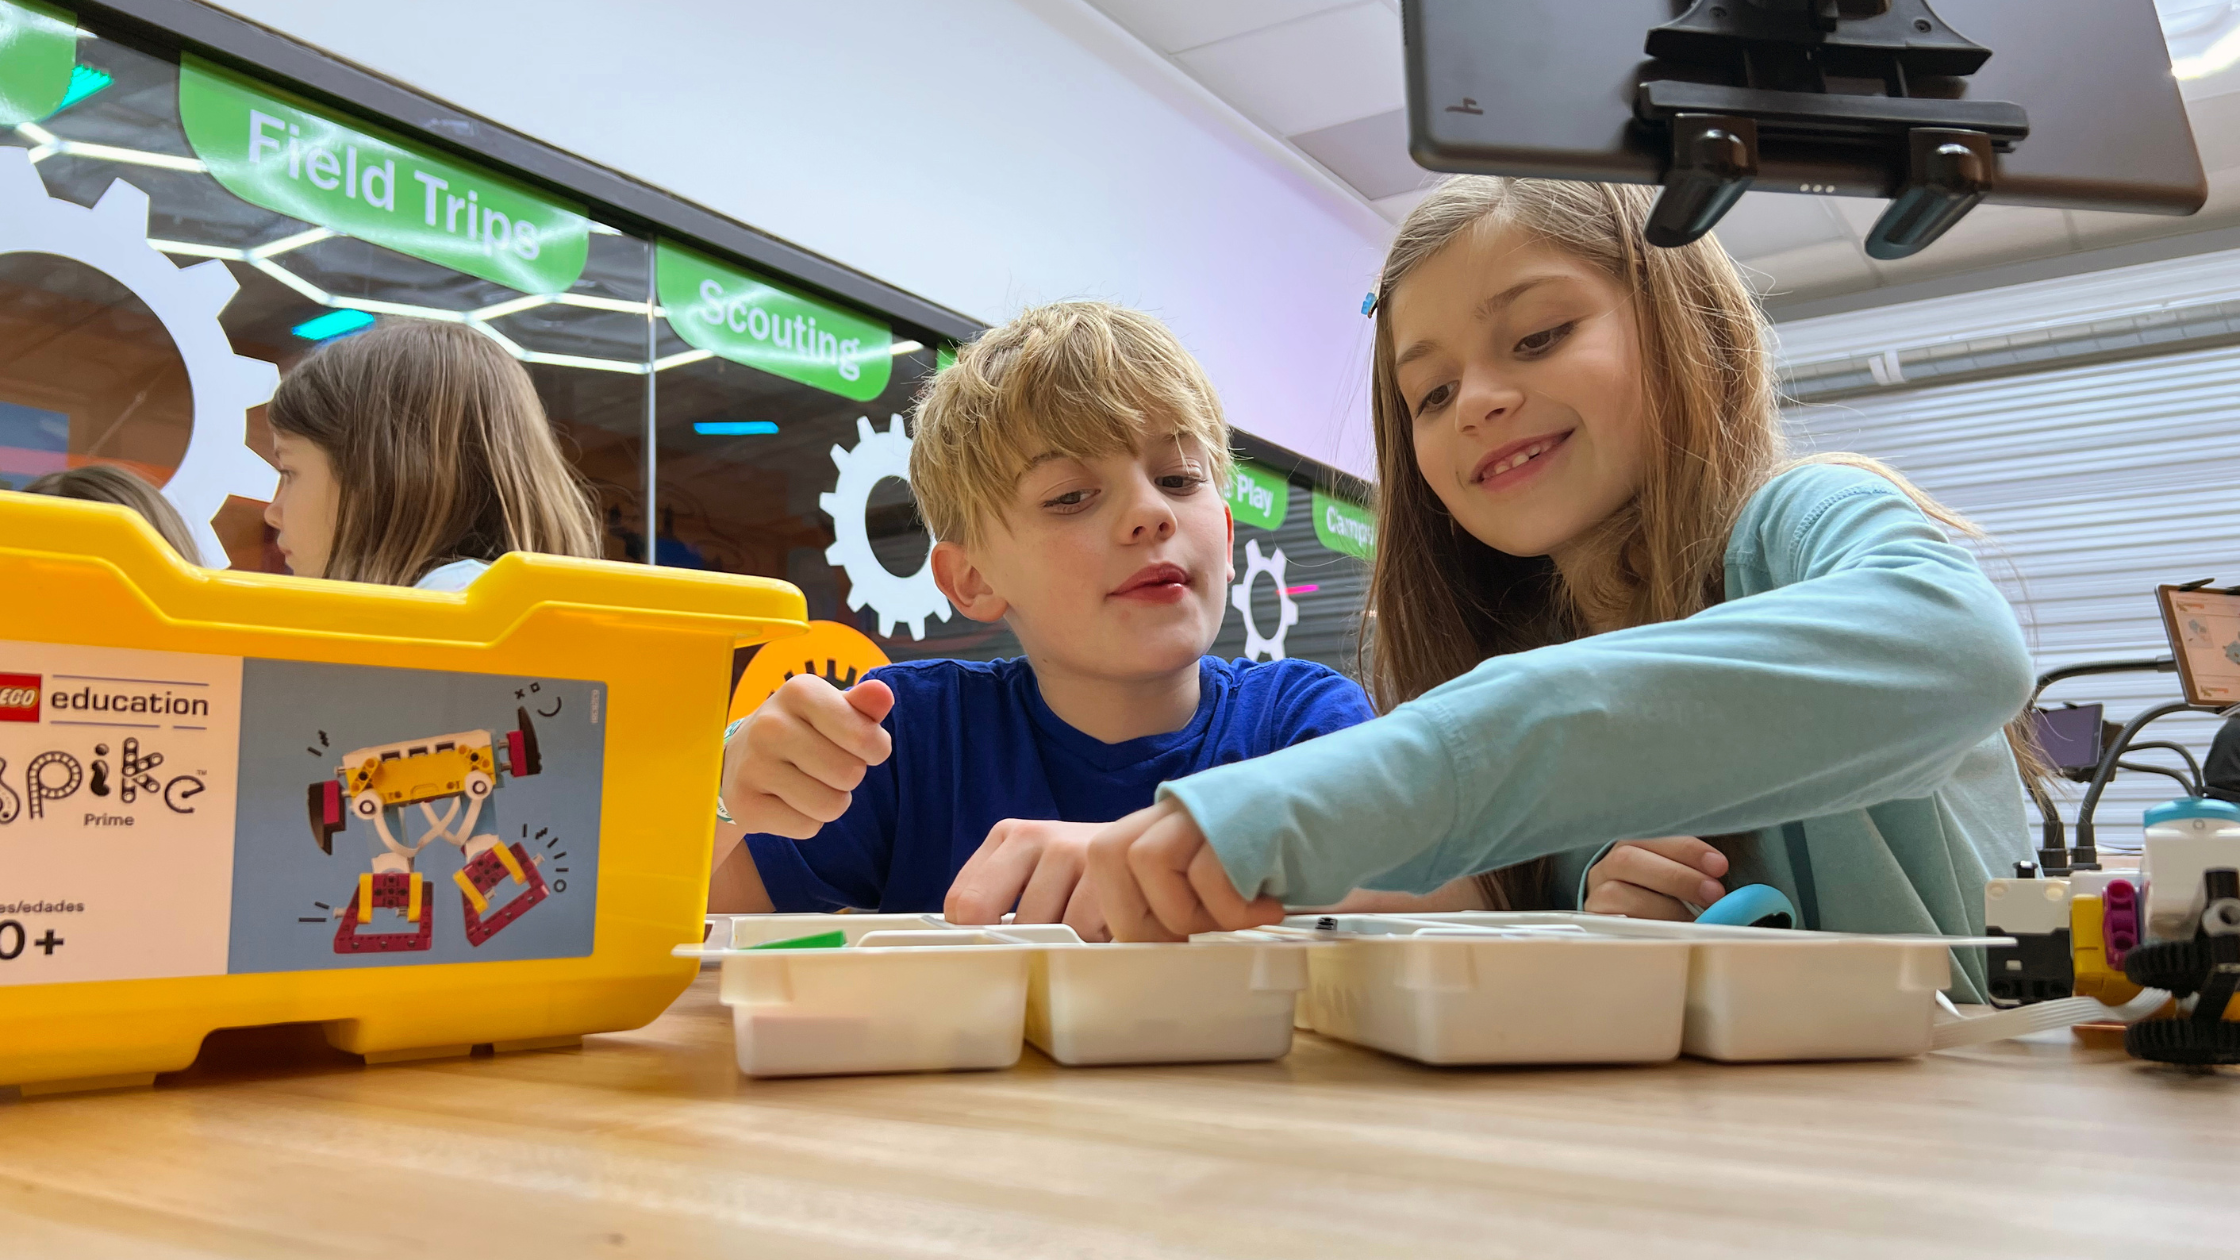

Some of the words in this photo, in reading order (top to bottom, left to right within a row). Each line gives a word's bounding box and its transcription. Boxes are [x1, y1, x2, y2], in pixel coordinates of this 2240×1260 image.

[249, 109, 395, 212] Field
[414, 170, 540, 260] Trips
[700, 279, 860, 381] Scouting
[1237, 474, 1274, 518] Play
[51, 687, 209, 716] education
[84, 813, 135, 826] Prime
